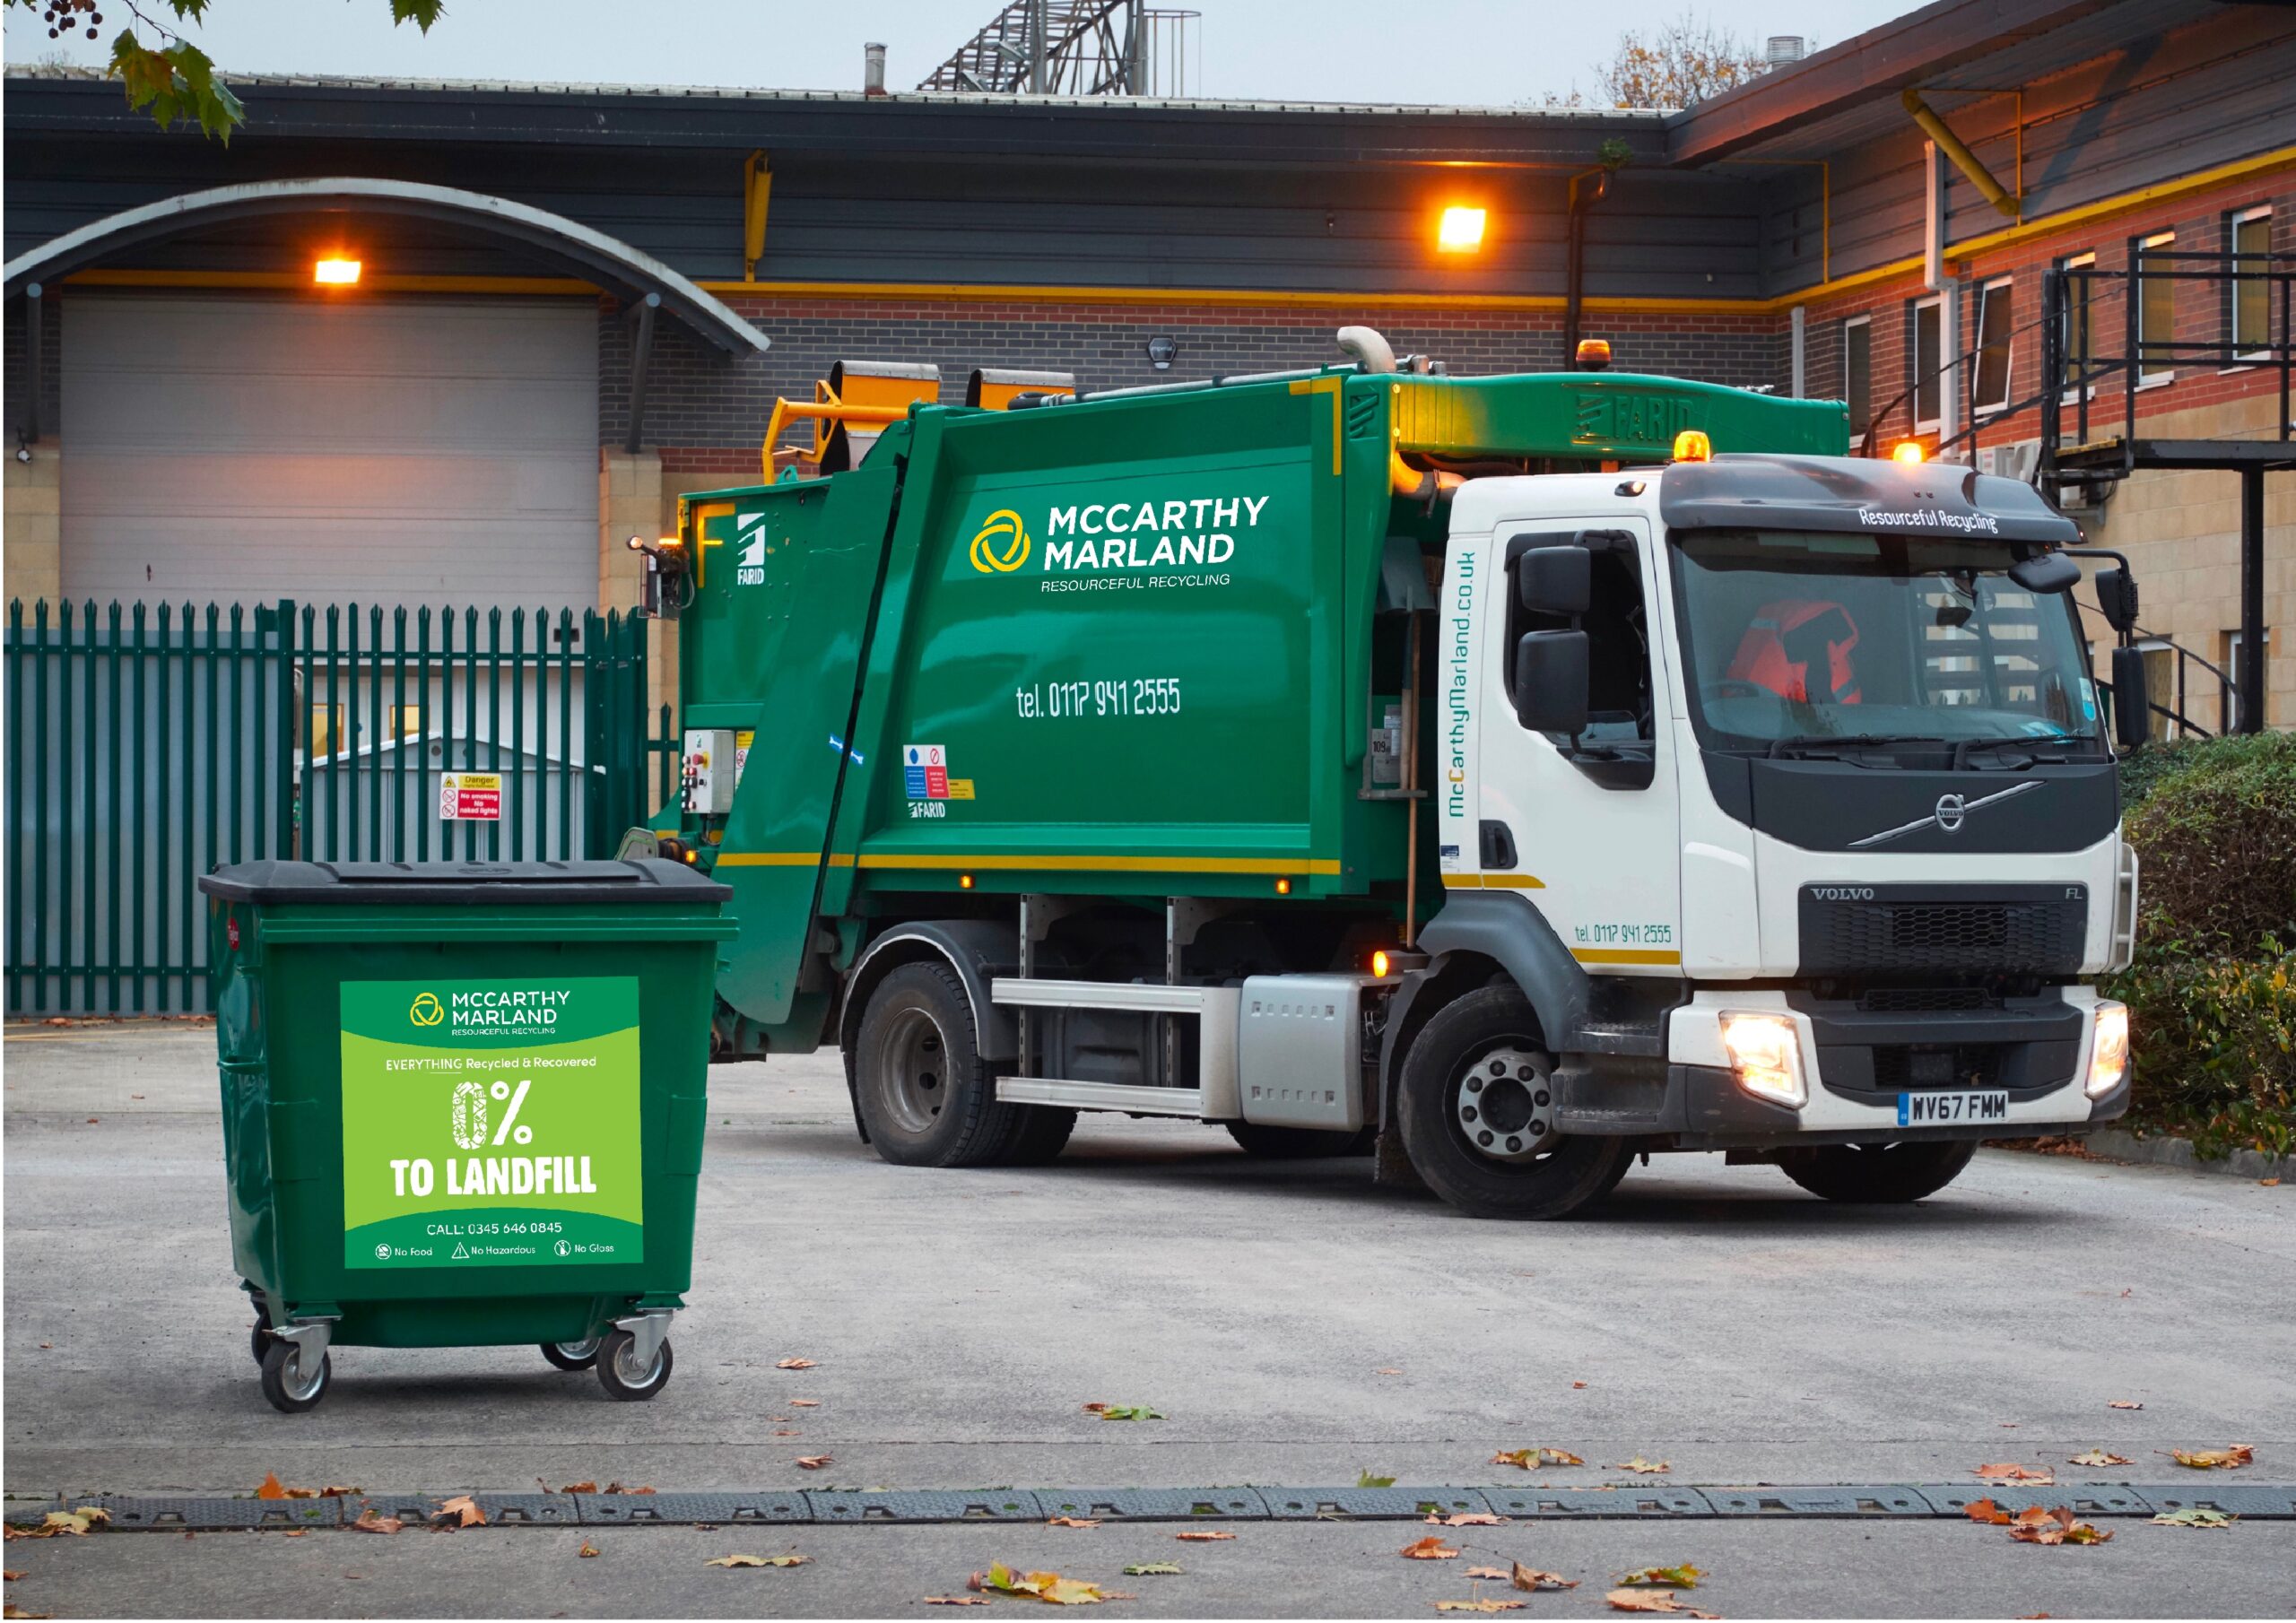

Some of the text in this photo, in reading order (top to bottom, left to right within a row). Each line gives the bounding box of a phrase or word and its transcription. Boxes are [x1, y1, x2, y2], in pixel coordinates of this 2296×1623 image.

[1048, 496, 1270, 536] MCCARTHY
[1858, 508, 1998, 534] Resourceful Recycling
[1044, 534, 1235, 571] MARLAND
[737, 568, 764, 586] FARID
[1041, 574, 1231, 593] RESOURCEFUL RECYCLING
[1016, 678, 1180, 718] tel. 0117 941 2555
[465, 777, 494, 785] Danger
[472, 794, 498, 802] smoking
[918, 802, 945, 818] FARID
[1811, 888, 1874, 900] VOLVO
[2066, 888, 2083, 899] FL
[1575, 924, 1672, 943] tel. 0117 941 2555
[452, 991, 570, 1007] MCCARTHY
[452, 1009, 557, 1026] MARLAND
[452, 1028, 509, 1036] RESOURCEFUL
[386, 1056, 596, 1071] EVERYTHING Recycled & Recovered
[452, 1080, 533, 1150] 0%
[1913, 1094, 2005, 1120] WV67 FMM
[389, 1156, 597, 1197] TO LANDFILL
[426, 1222, 562, 1236] CALL: 0345 646 0845
[395, 1247, 432, 1256] No Food
[471, 1245, 535, 1255] No Hazardous
[574, 1244, 614, 1253] No Glass
